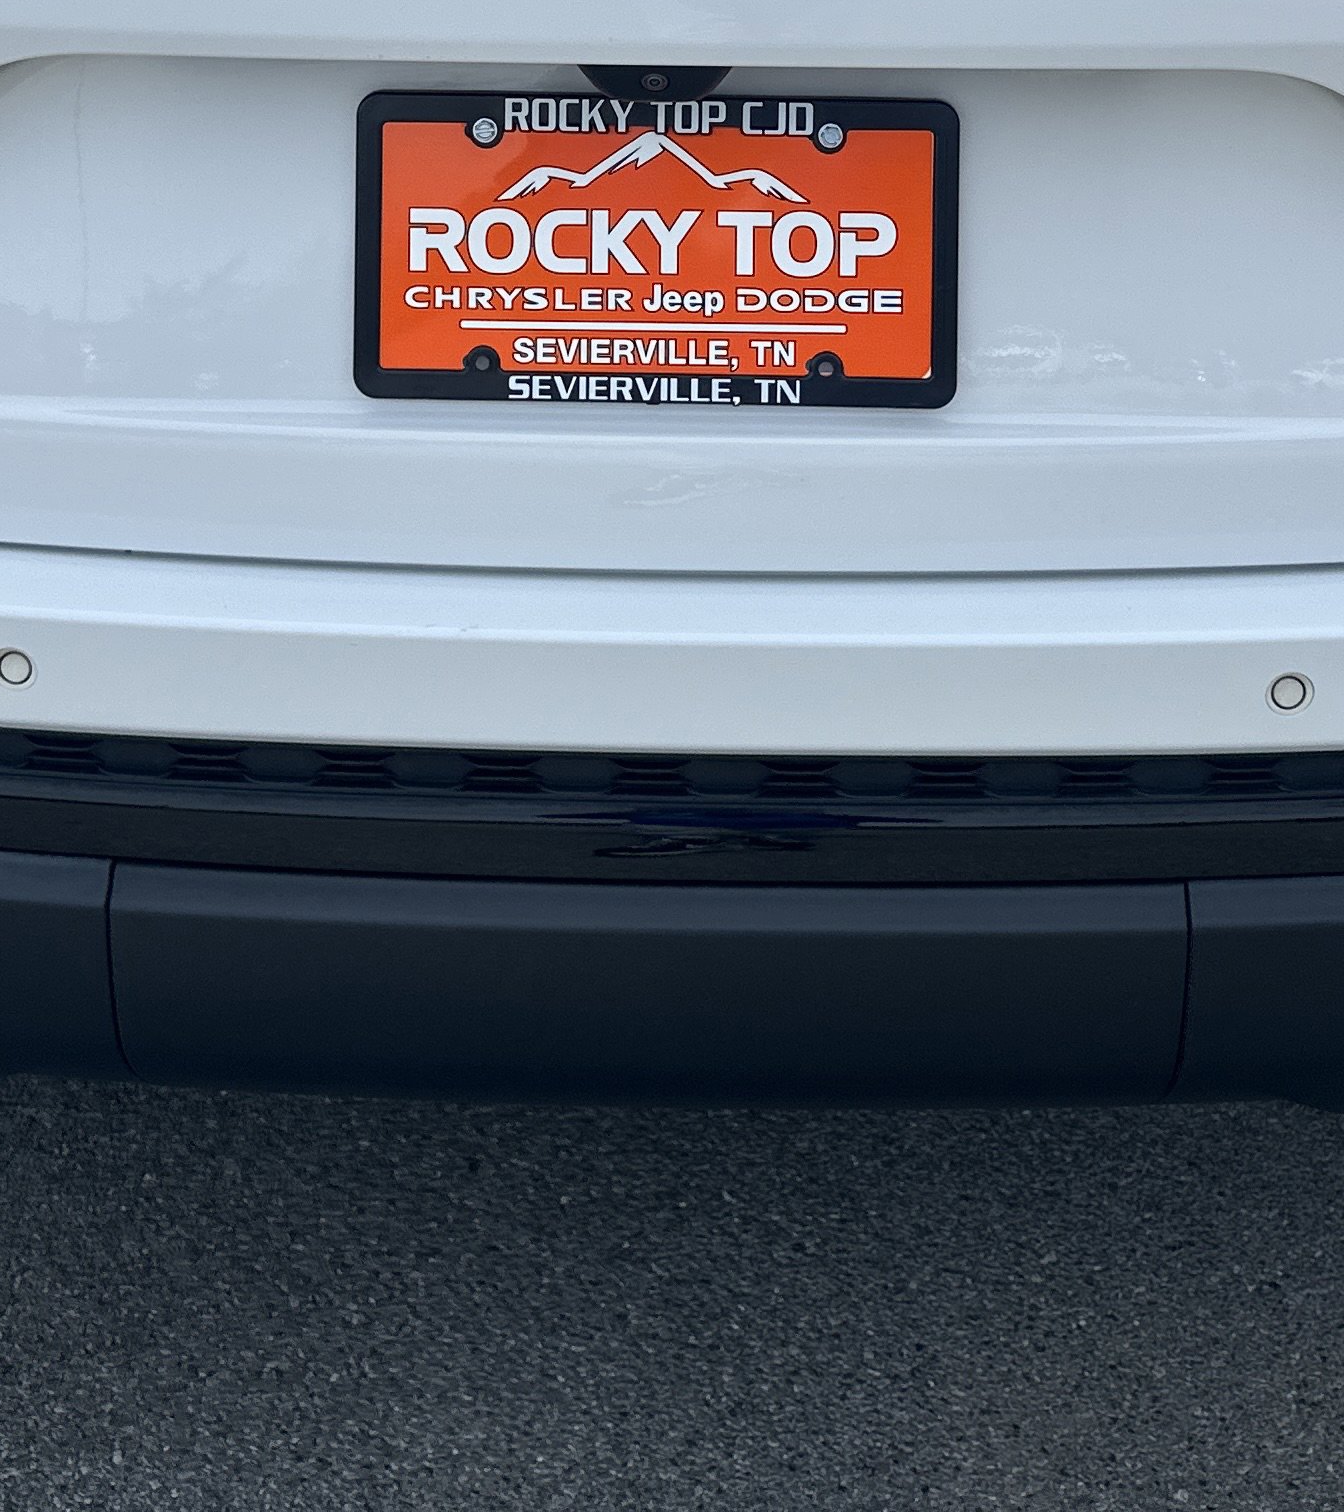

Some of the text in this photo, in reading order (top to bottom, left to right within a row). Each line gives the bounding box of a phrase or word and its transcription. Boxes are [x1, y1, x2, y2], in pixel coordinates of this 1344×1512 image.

[504, 97, 816, 136] ROCKY TOP CJD
[408, 207, 899, 277] ROCKY TOP
[404, 284, 904, 317] CHRYSLER Jeep DODGE
[512, 338, 796, 372] SEVIERVILLE, TN
[508, 375, 801, 406] SEVIERVILLE, TN
